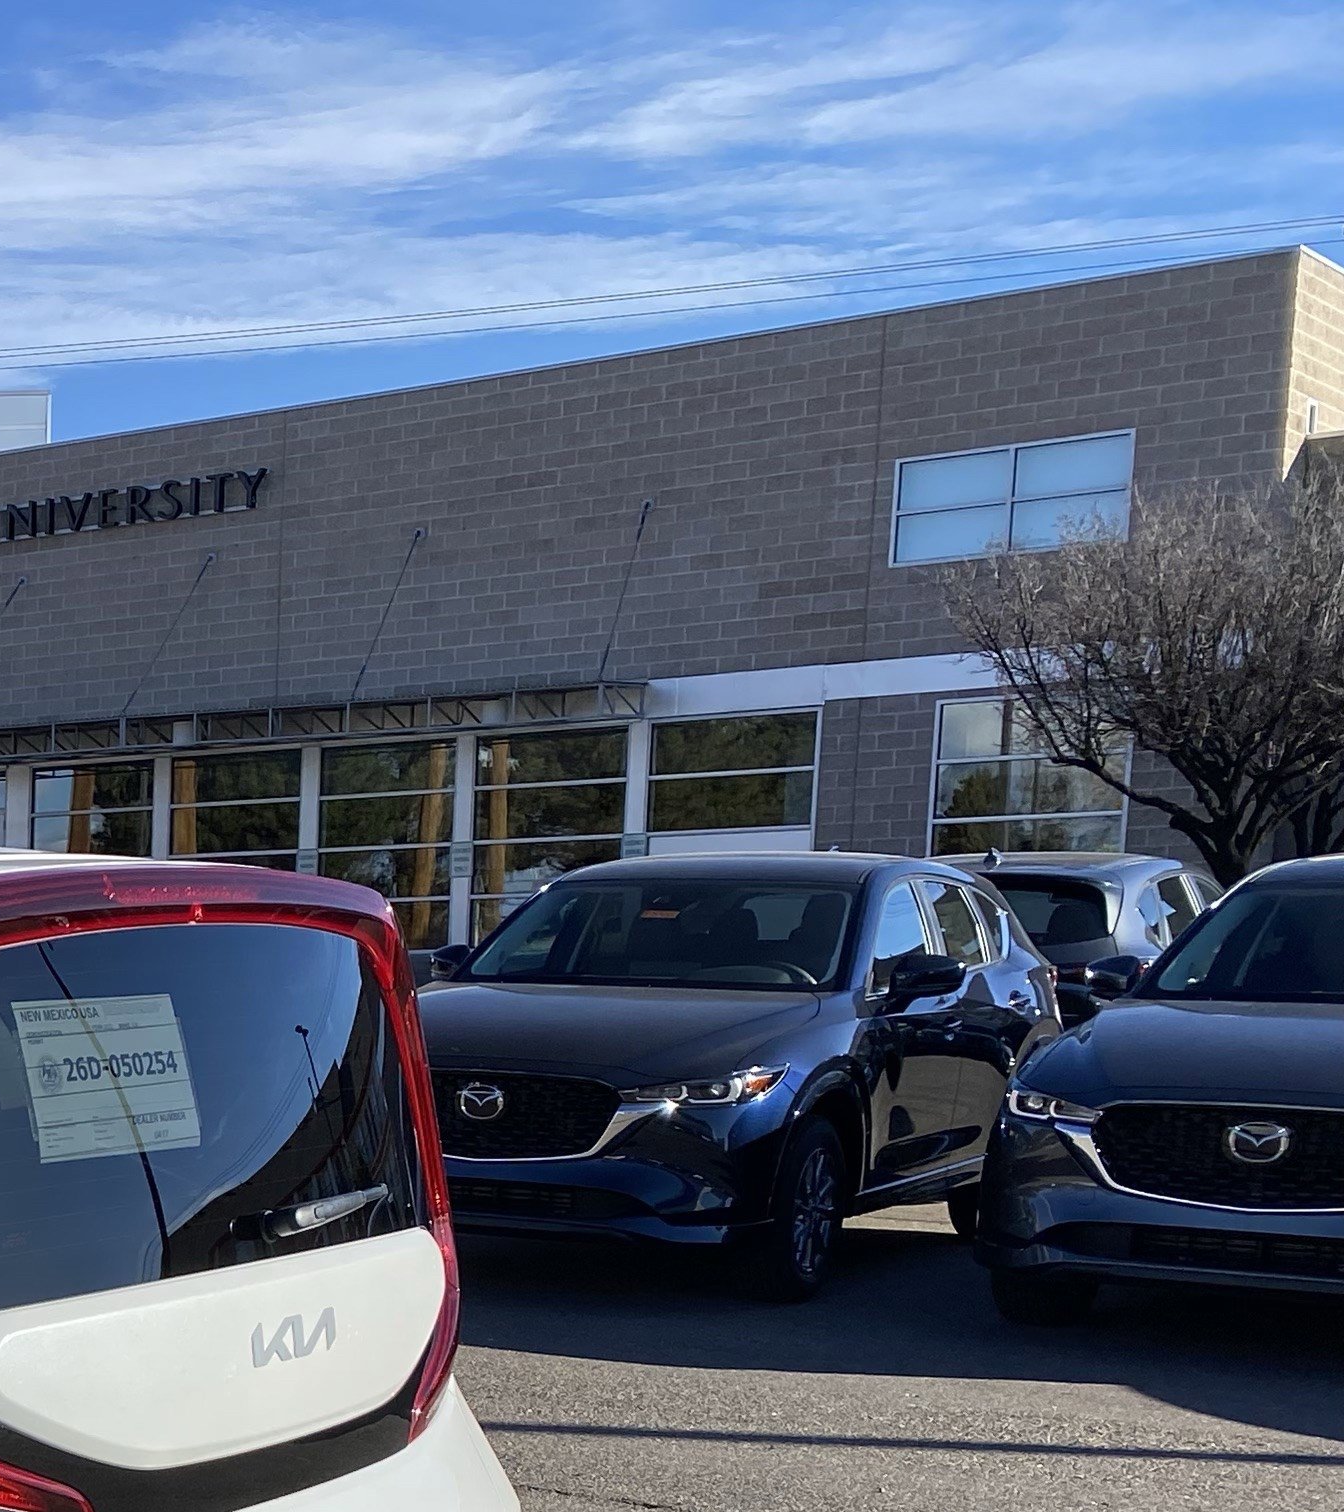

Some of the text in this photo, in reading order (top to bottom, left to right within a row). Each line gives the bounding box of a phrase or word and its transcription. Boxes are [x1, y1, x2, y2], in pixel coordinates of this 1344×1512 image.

[19, 1006, 100, 1023] NEW MEXICO USA
[63, 1050, 178, 1082] 26D-050254
[160, 1111, 187, 1122] NUMBER
[251, 1306, 336, 1369] KIA
